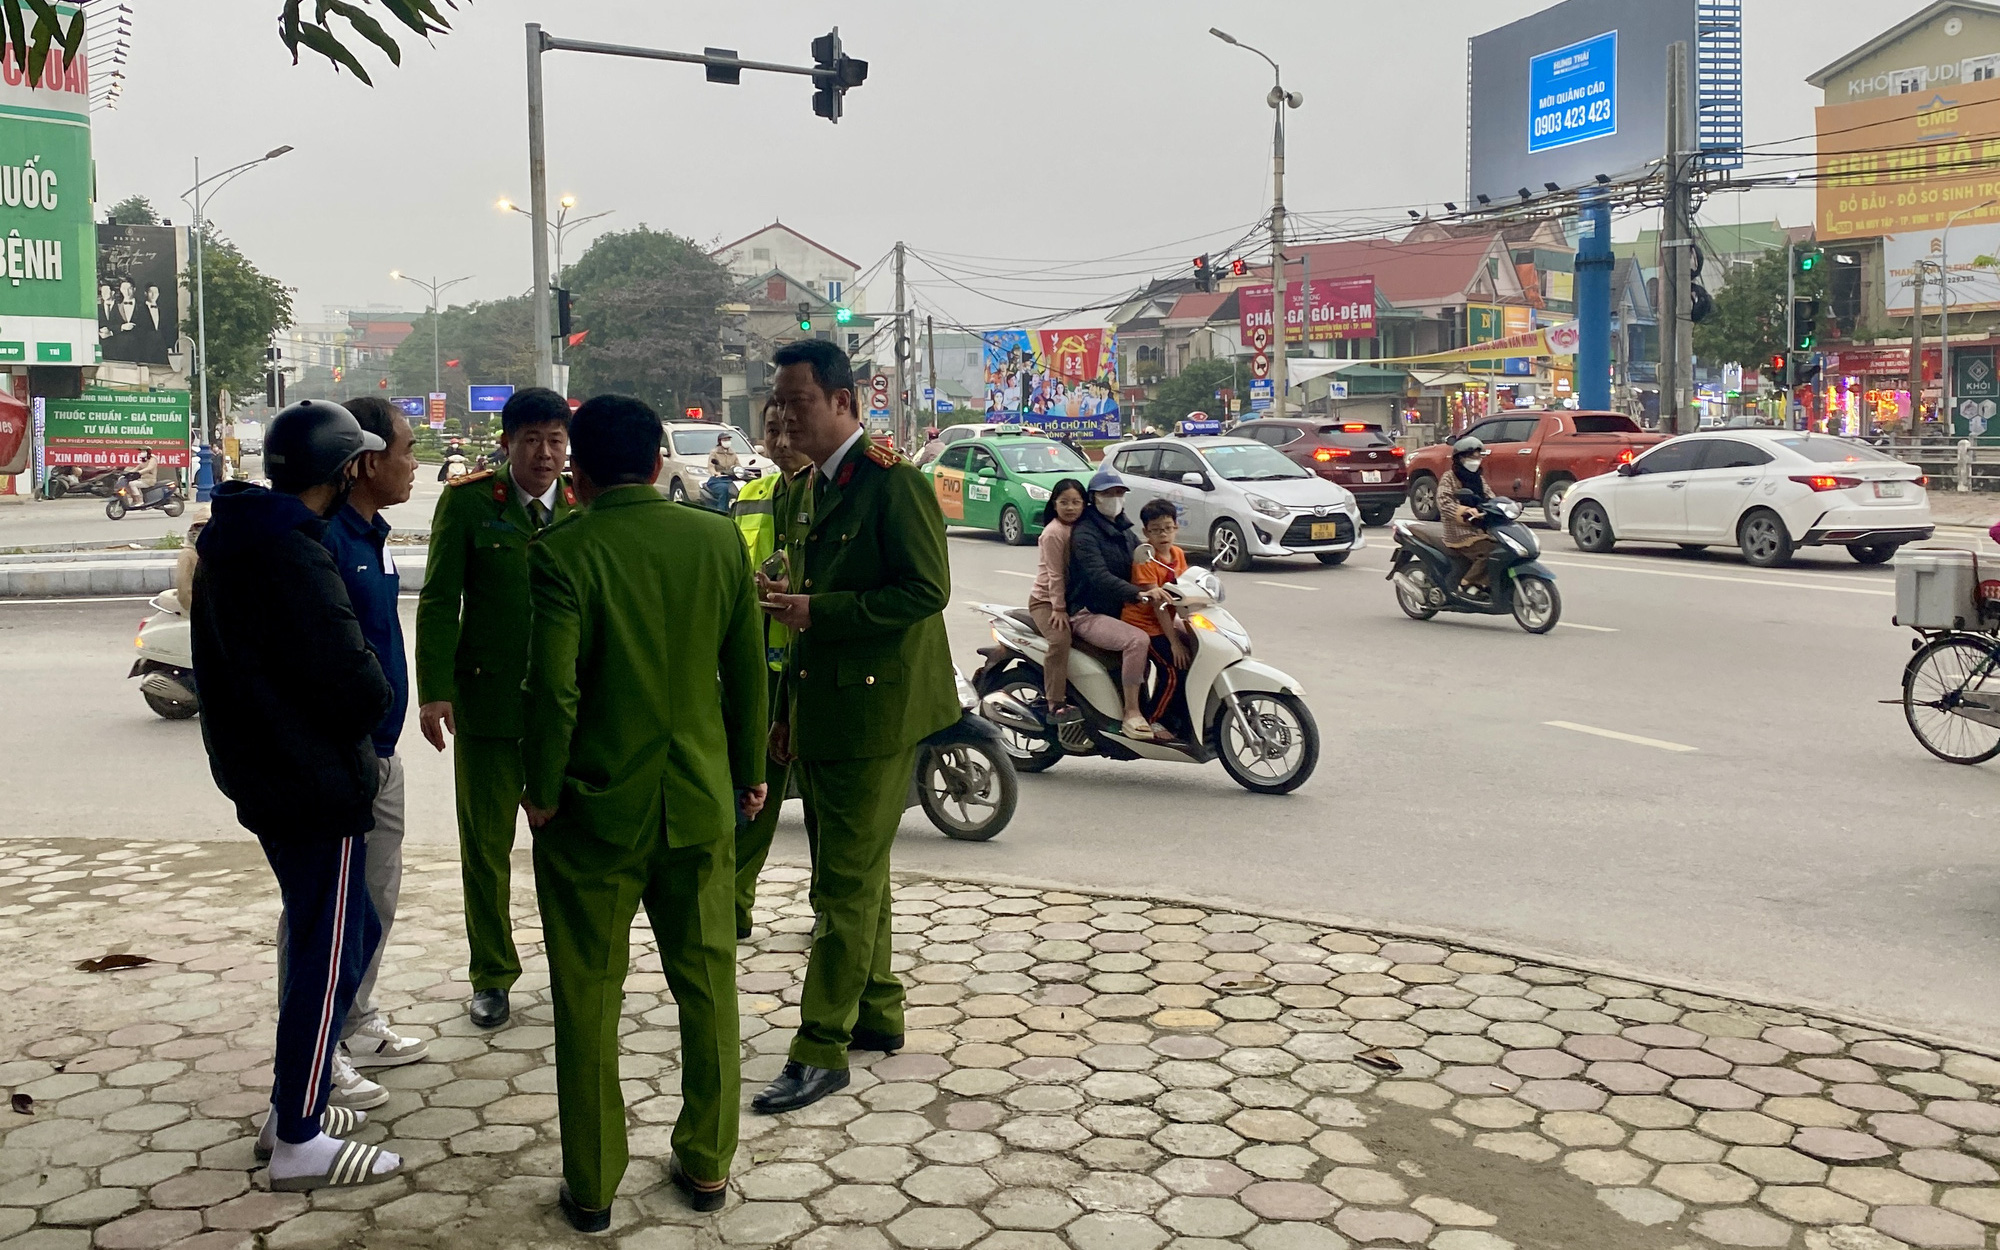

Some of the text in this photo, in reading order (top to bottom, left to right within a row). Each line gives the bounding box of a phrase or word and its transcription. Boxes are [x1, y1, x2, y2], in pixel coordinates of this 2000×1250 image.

[1539, 80, 1606, 109] MỜI QUẢNG CÁO
[1534, 98, 1611, 137] 0903 423 423
[1916, 107, 1959, 128] BMB
[0, 155, 58, 211] UỐC
[1942, 185, 1974, 200] SINH
[1065, 356, 1081, 370] 3-2
[114, 393, 138, 403] THUỐC
[53, 409, 86, 420] THUỐC
[130, 411, 147, 422] GIÁ
[83, 424, 97, 434] TƯ
[943, 478, 961, 493] FWD
